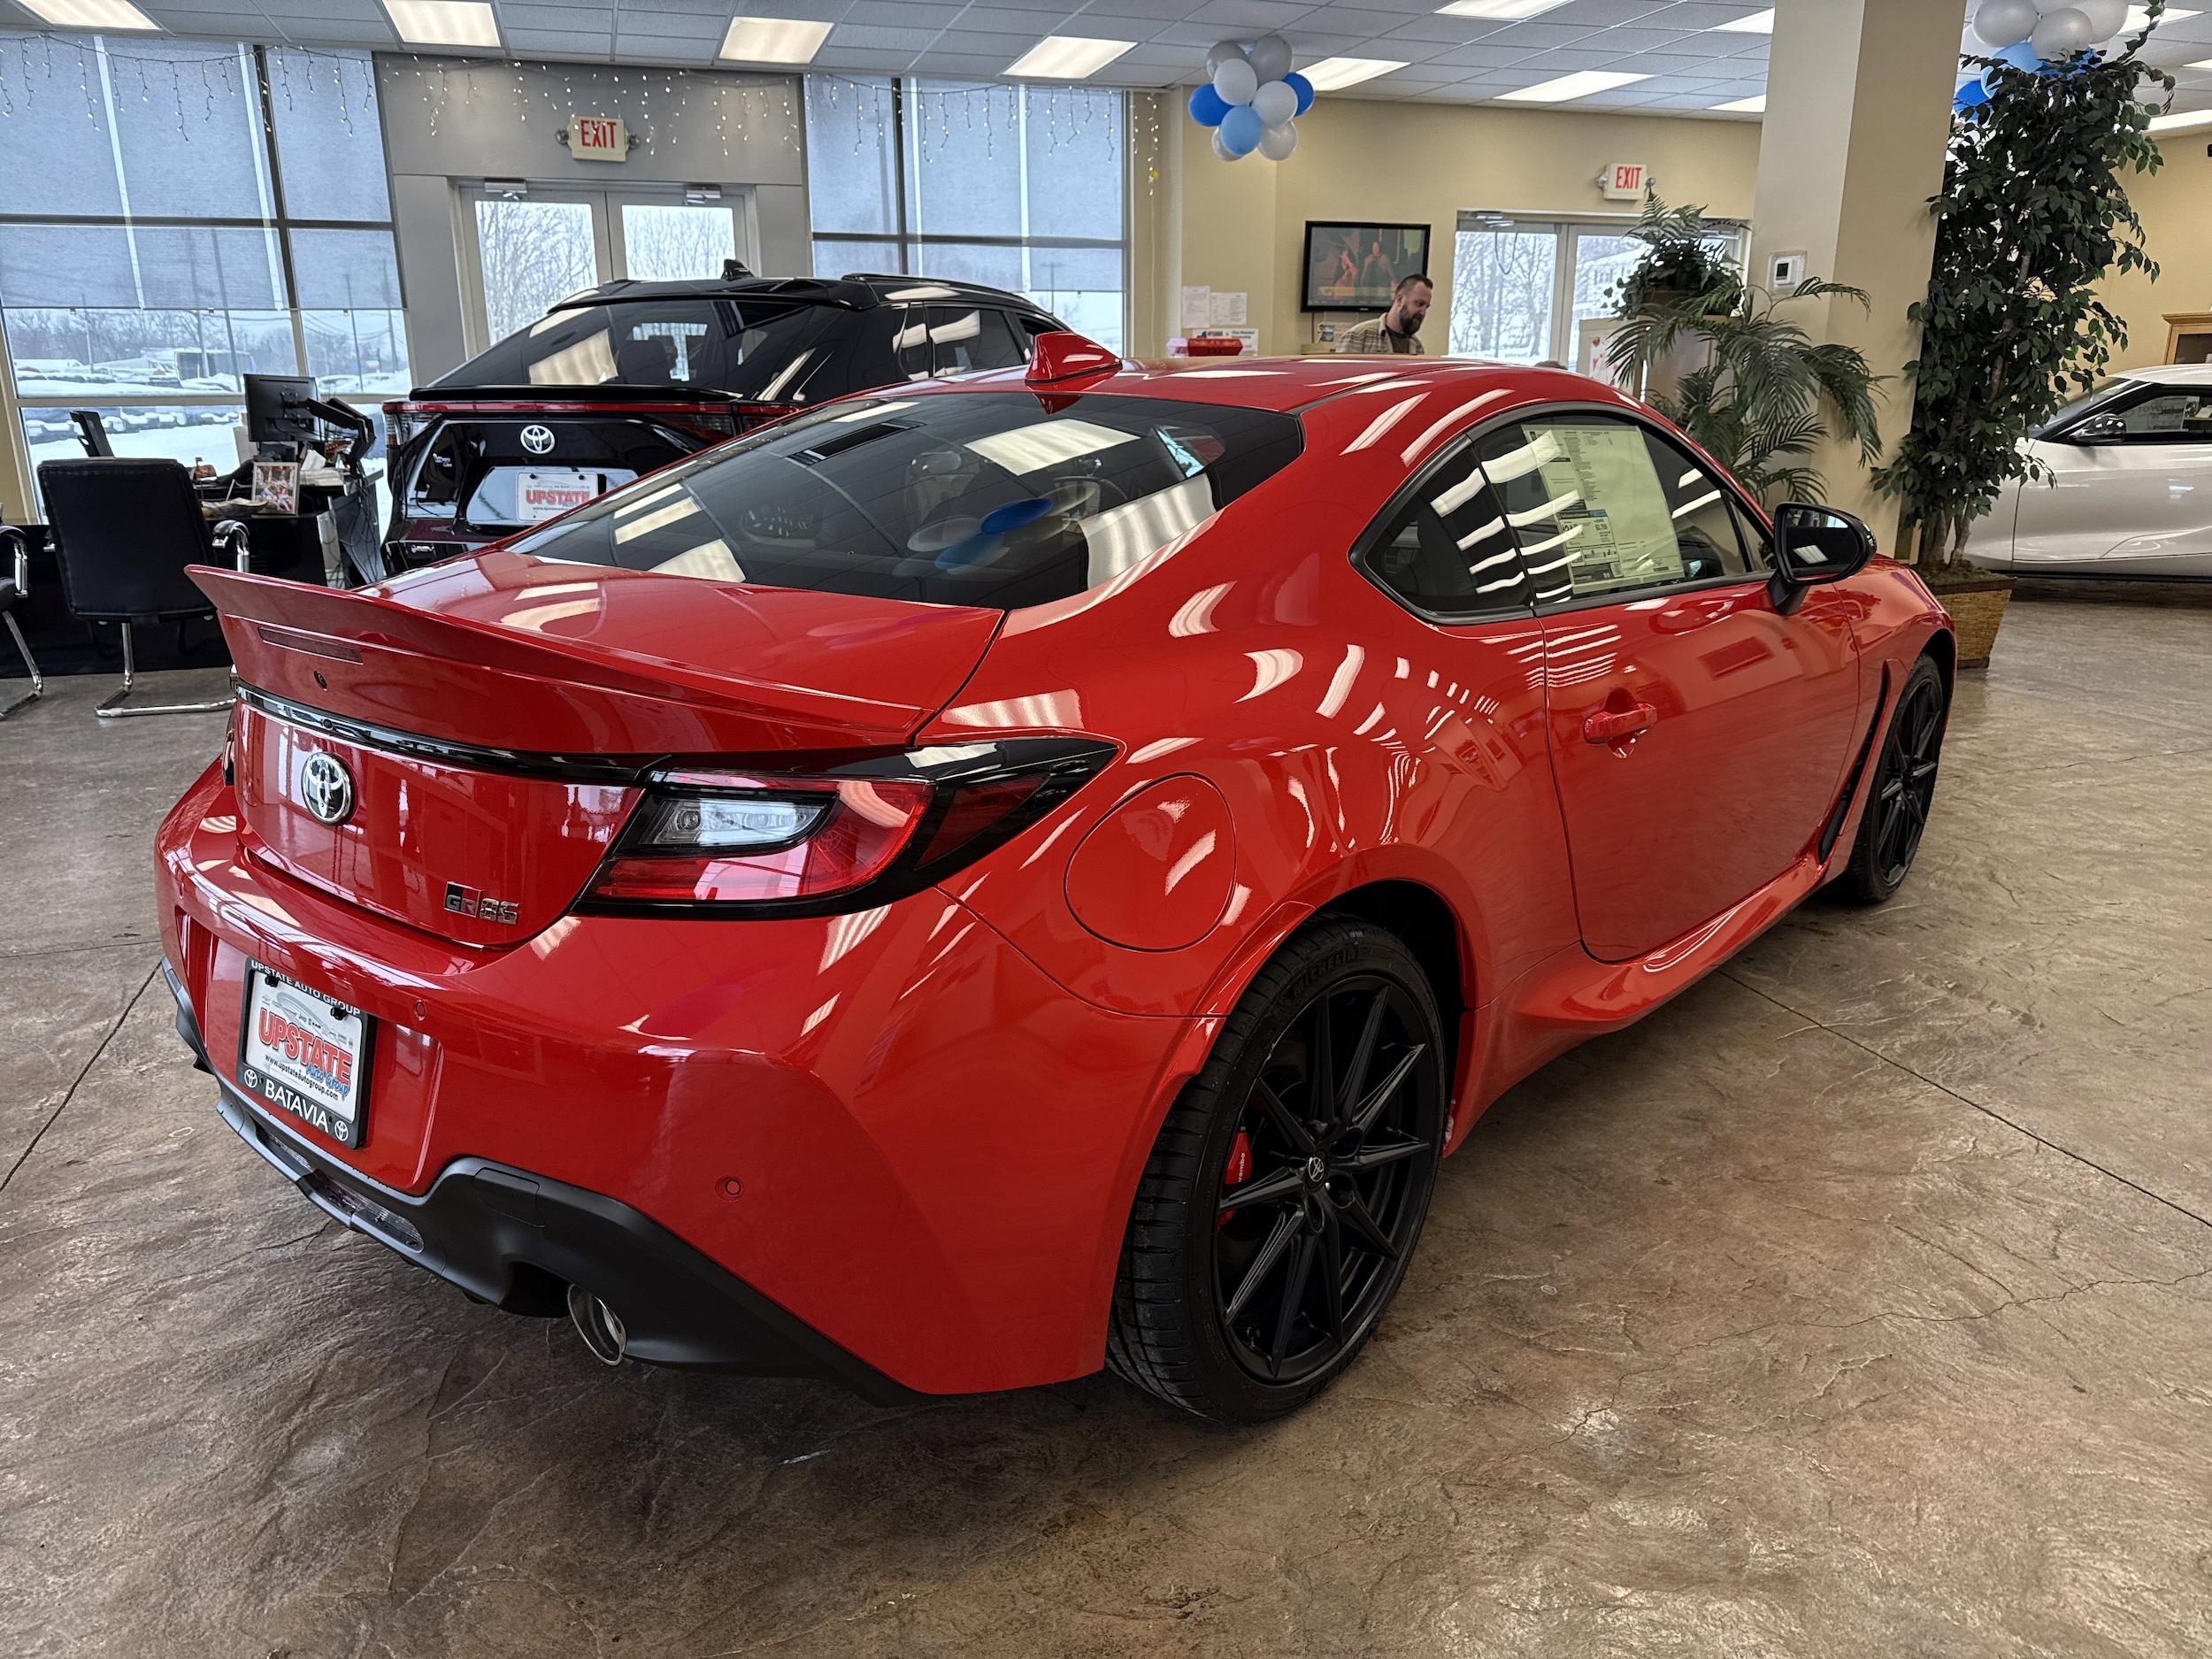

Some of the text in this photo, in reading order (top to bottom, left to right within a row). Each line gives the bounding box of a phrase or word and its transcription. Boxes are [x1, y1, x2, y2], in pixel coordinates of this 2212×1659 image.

[580, 120, 617, 149] EXIT
[1616, 166, 1642, 189] EXIT
[526, 488, 591, 507] UPSTATE
[250, 959, 294, 986] UPSTATE
[295, 980, 320, 999] AUTO
[323, 993, 361, 1016] GROUP
[1292, 946, 1360, 999] MICHELIN
[258, 1007, 353, 1086] UPSTATE
[265, 1054, 339, 1102] www.upstateautogroup.com
[305, 1064, 350, 1096] Auto Group
[265, 1079, 329, 1133] BATAVIA
